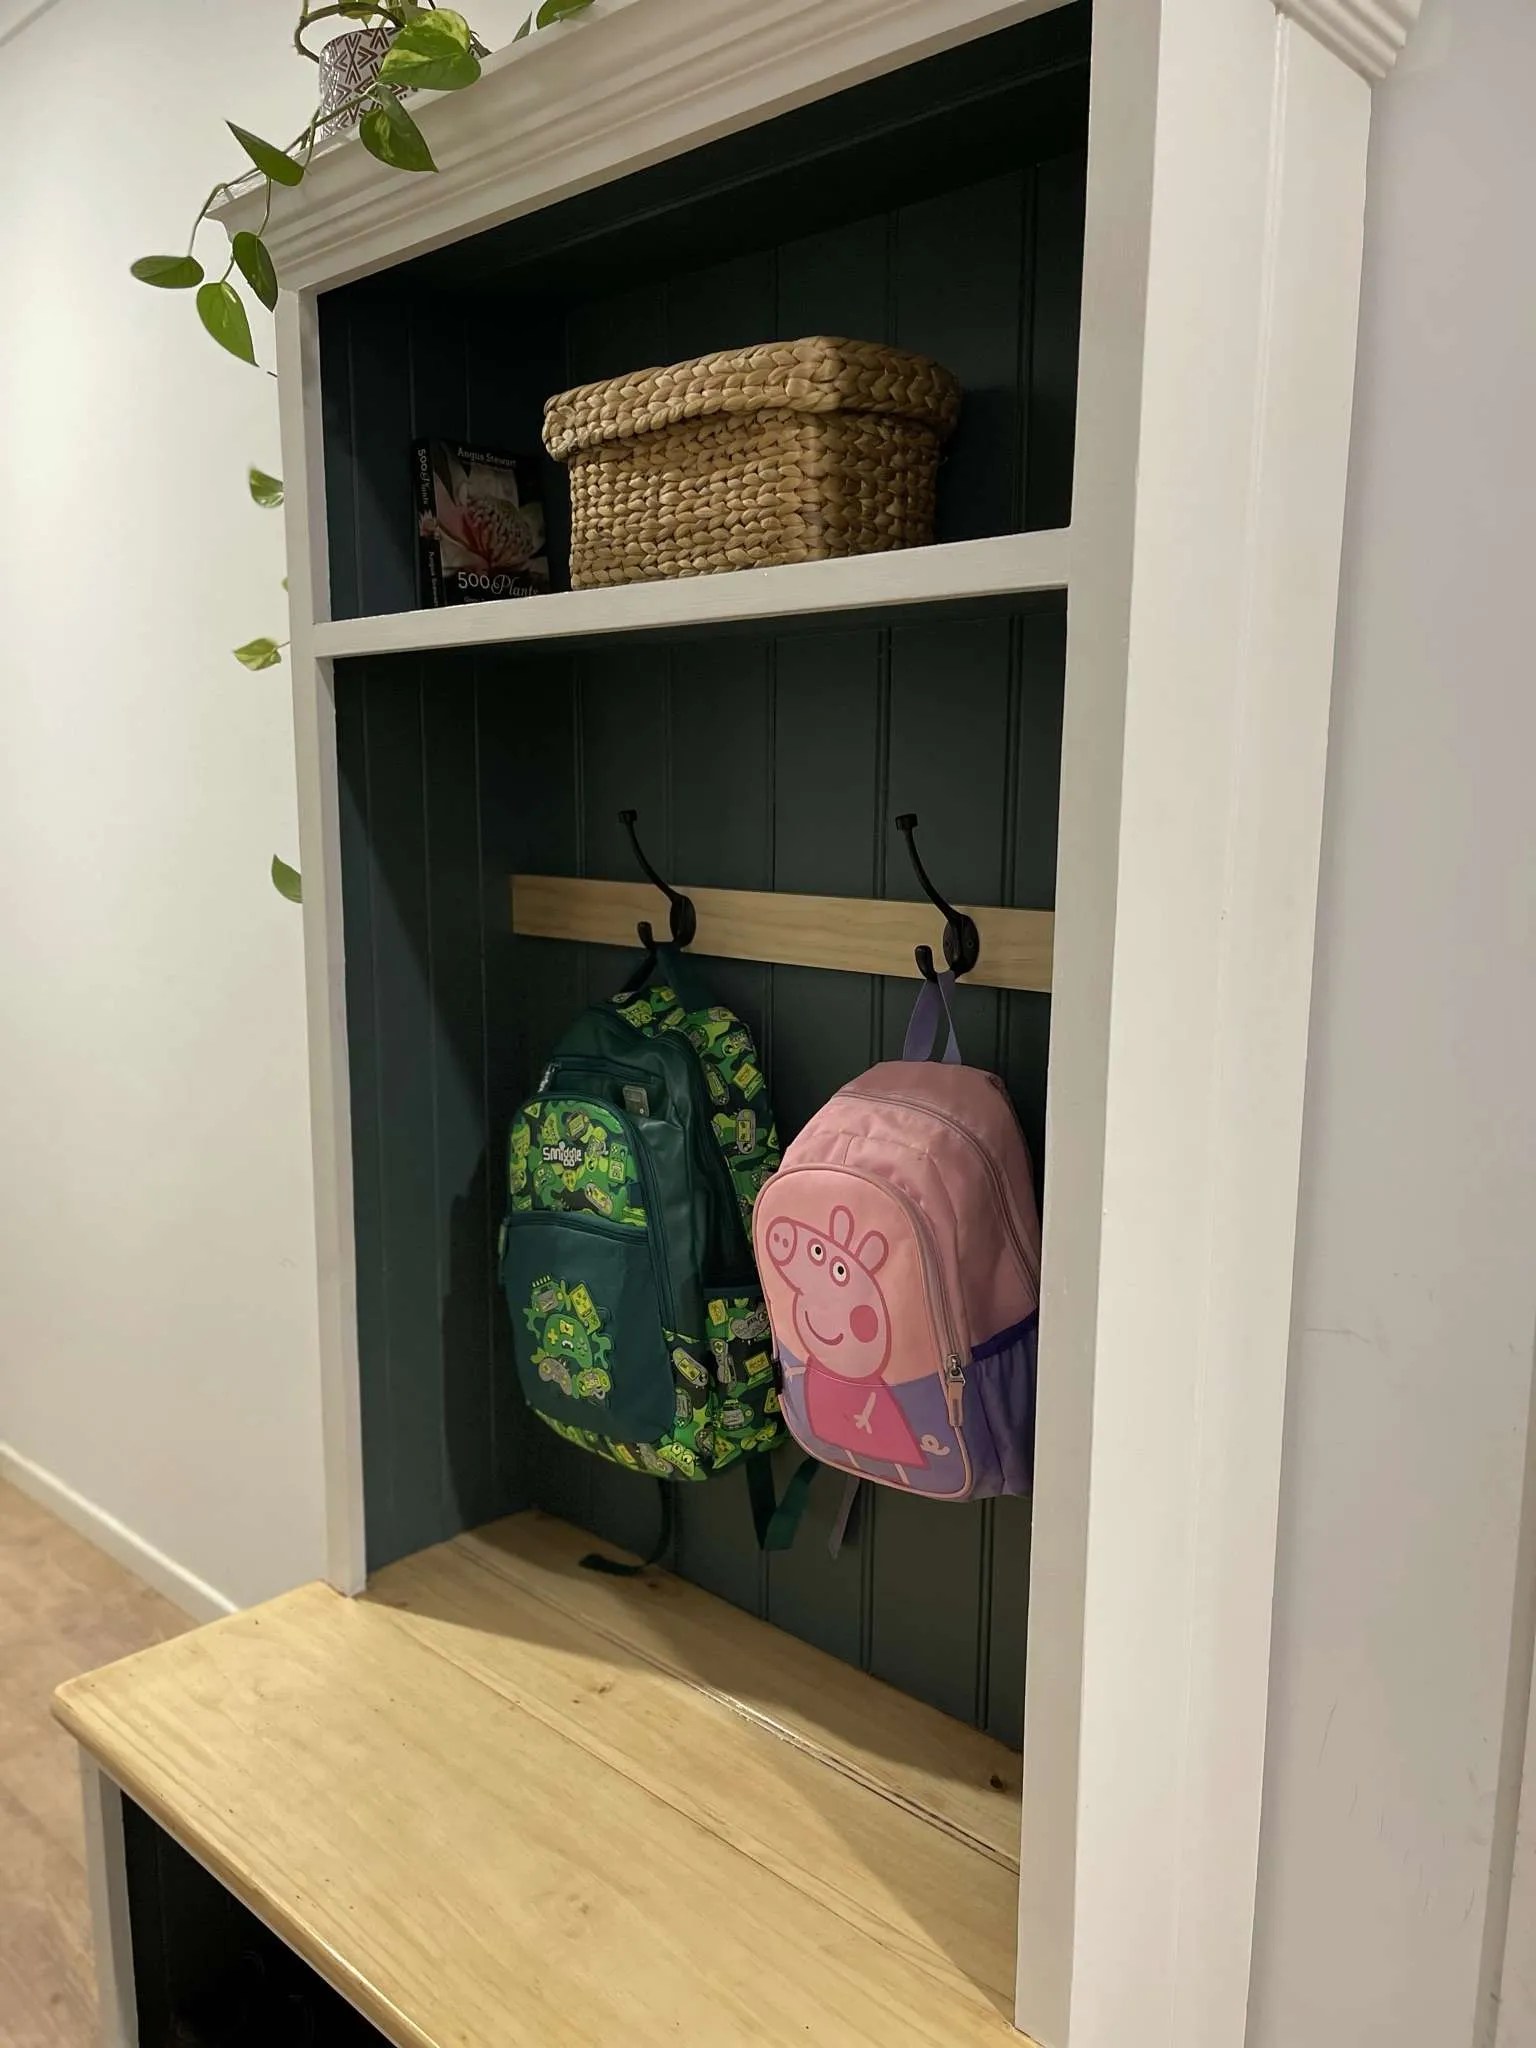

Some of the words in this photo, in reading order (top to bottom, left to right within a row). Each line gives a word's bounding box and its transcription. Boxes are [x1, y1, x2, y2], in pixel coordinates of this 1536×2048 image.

[417, 448, 428, 472] 500
[457, 447, 485, 462] Angus
[457, 571, 490, 589] 500
[490, 574, 538, 597] Plants
